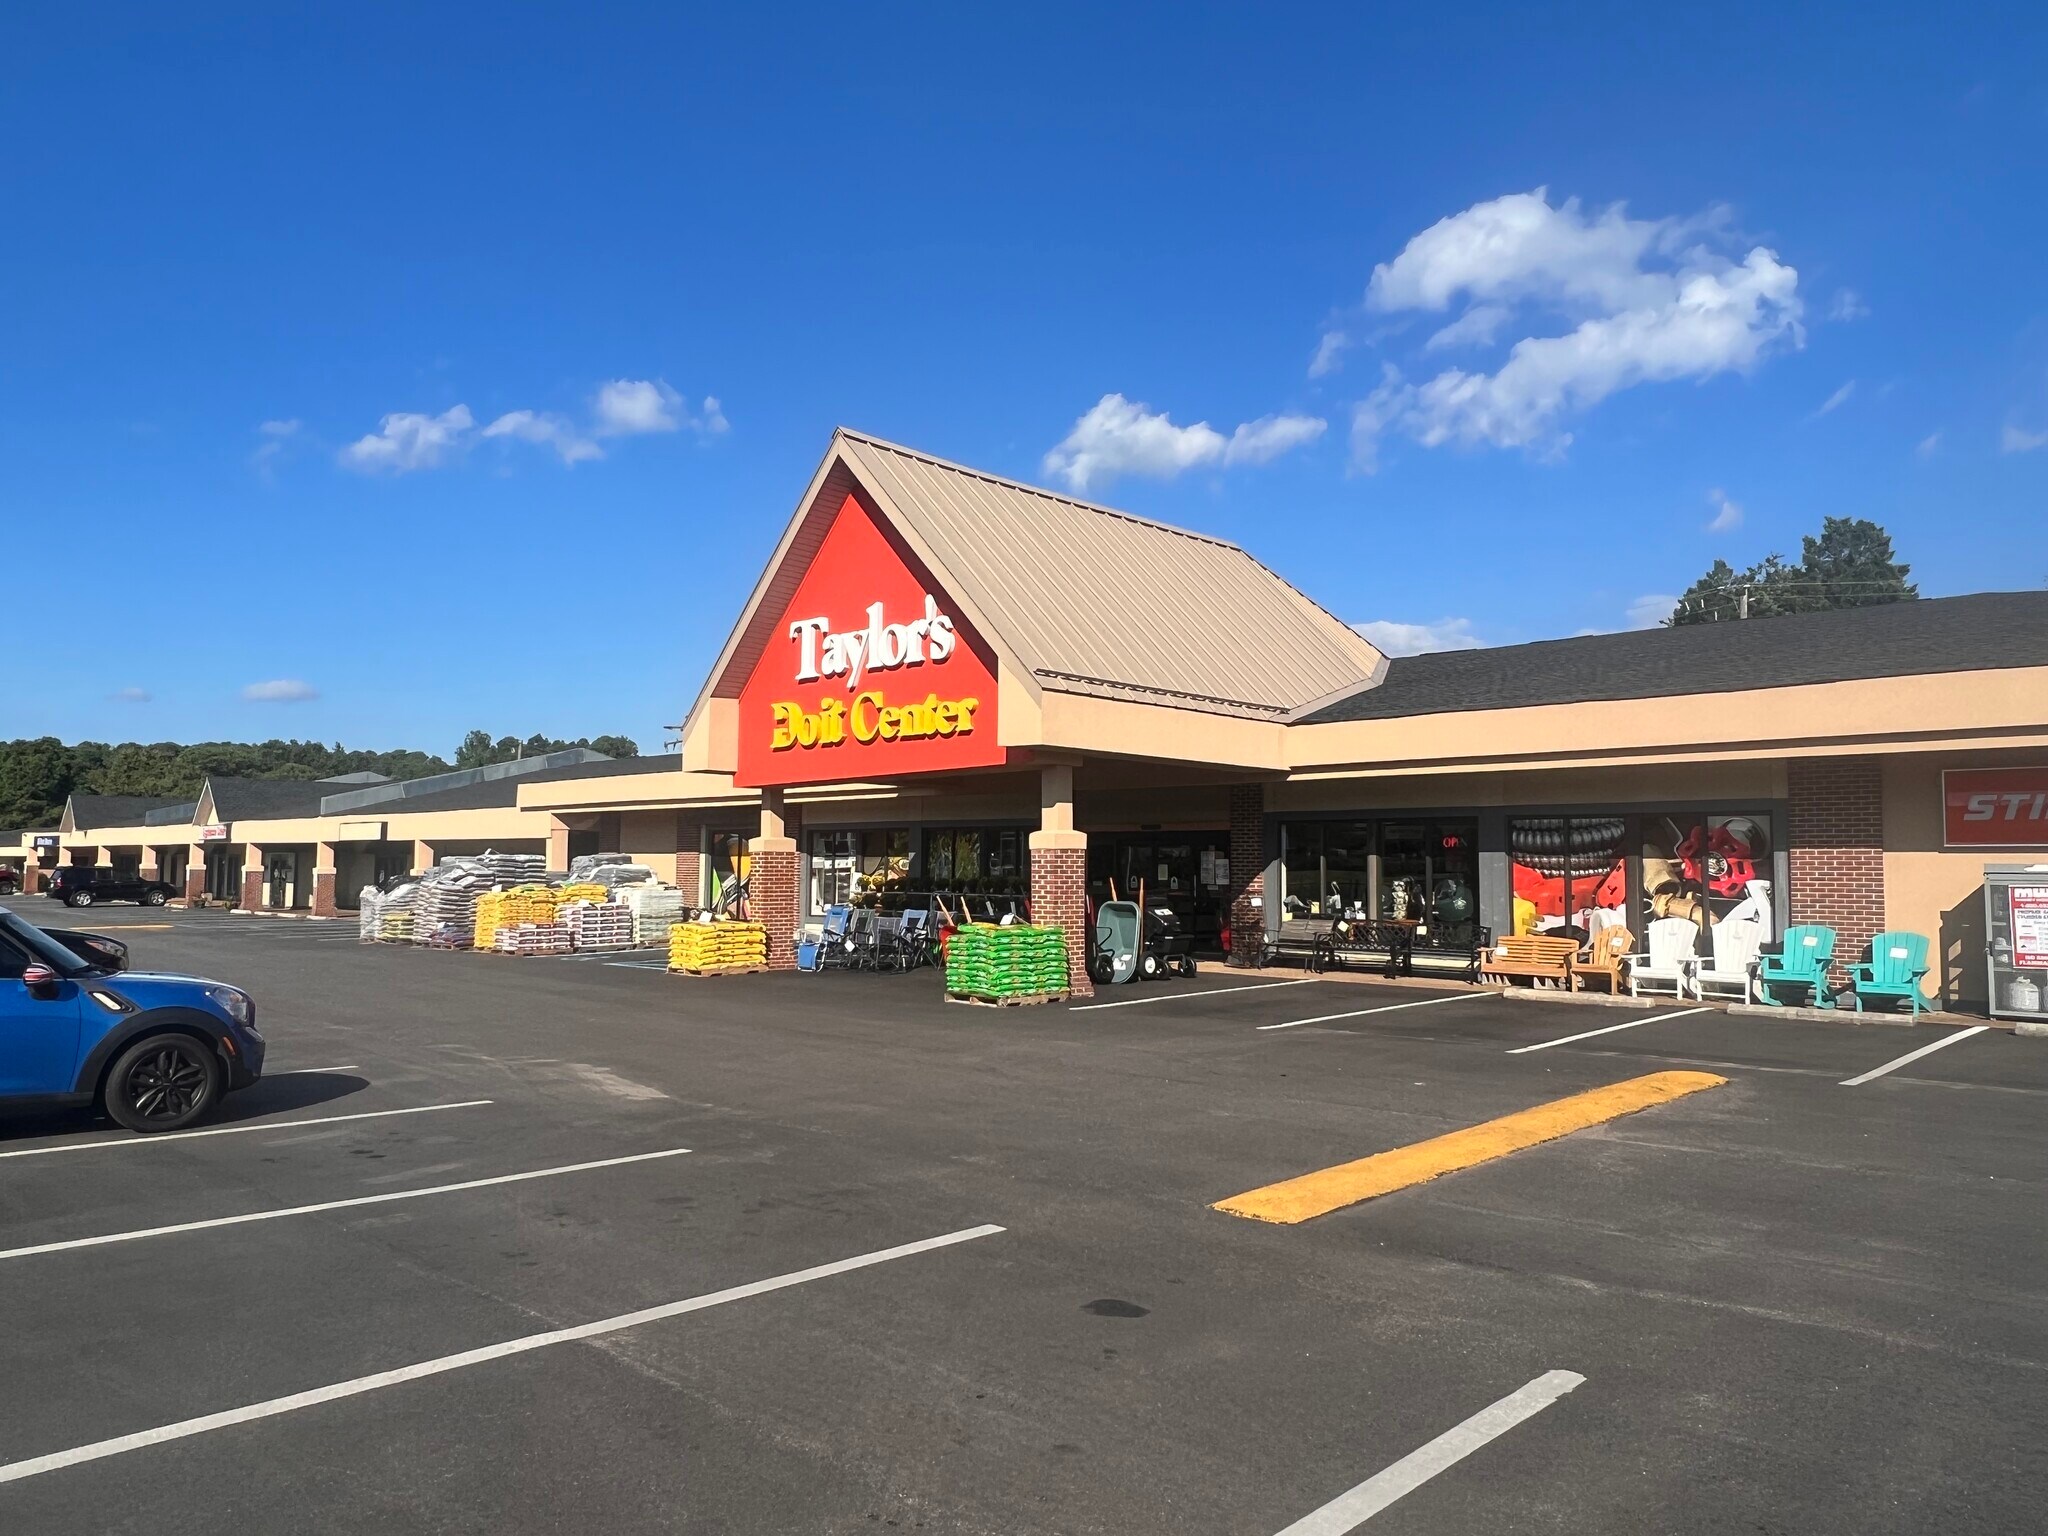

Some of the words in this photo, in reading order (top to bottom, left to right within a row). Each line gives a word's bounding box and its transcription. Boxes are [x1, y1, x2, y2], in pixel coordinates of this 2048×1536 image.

[789, 594, 955, 690] Taylor's
[850, 691, 980, 742] Center
[1964, 793, 2048, 820] STI
